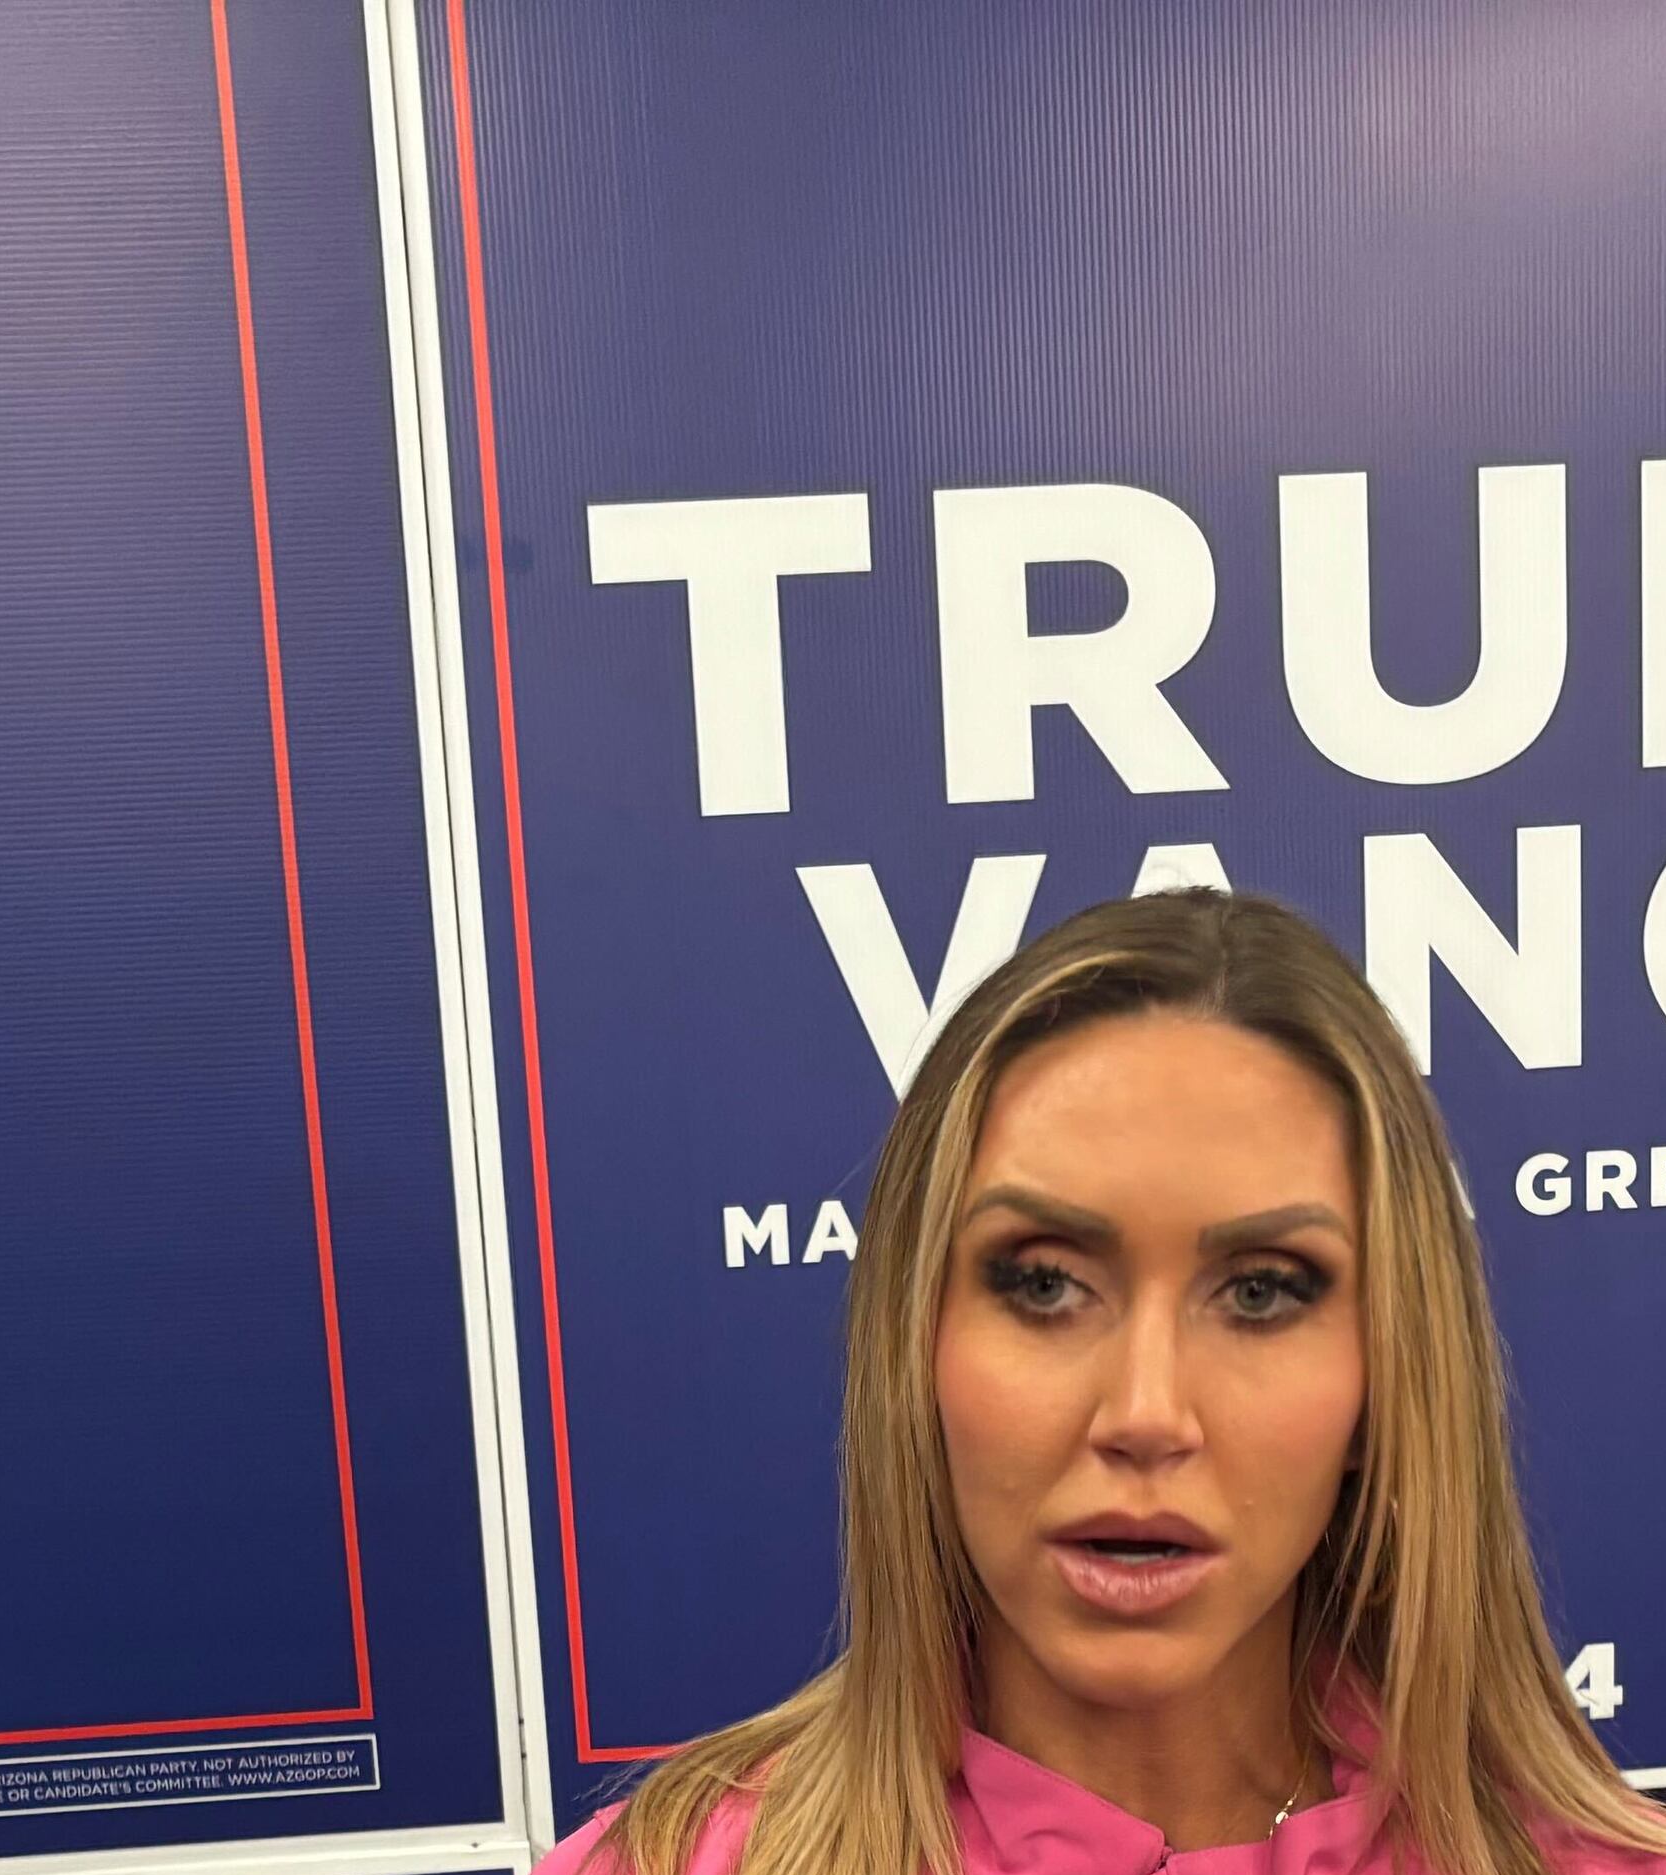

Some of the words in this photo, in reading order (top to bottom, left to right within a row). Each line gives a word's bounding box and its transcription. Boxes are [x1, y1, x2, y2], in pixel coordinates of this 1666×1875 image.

[52, 1763, 147, 1782] REPUBLICAN
[204, 1758, 234, 1771] NOT
[238, 1751, 333, 1769] AUTHORIZED
[337, 1749, 356, 1763] BY
[8, 1788, 30, 1802] OR
[34, 1781, 132, 1800] CANDIDATE'S
[228, 1765, 360, 1786] WWW.AZGOP.COM
